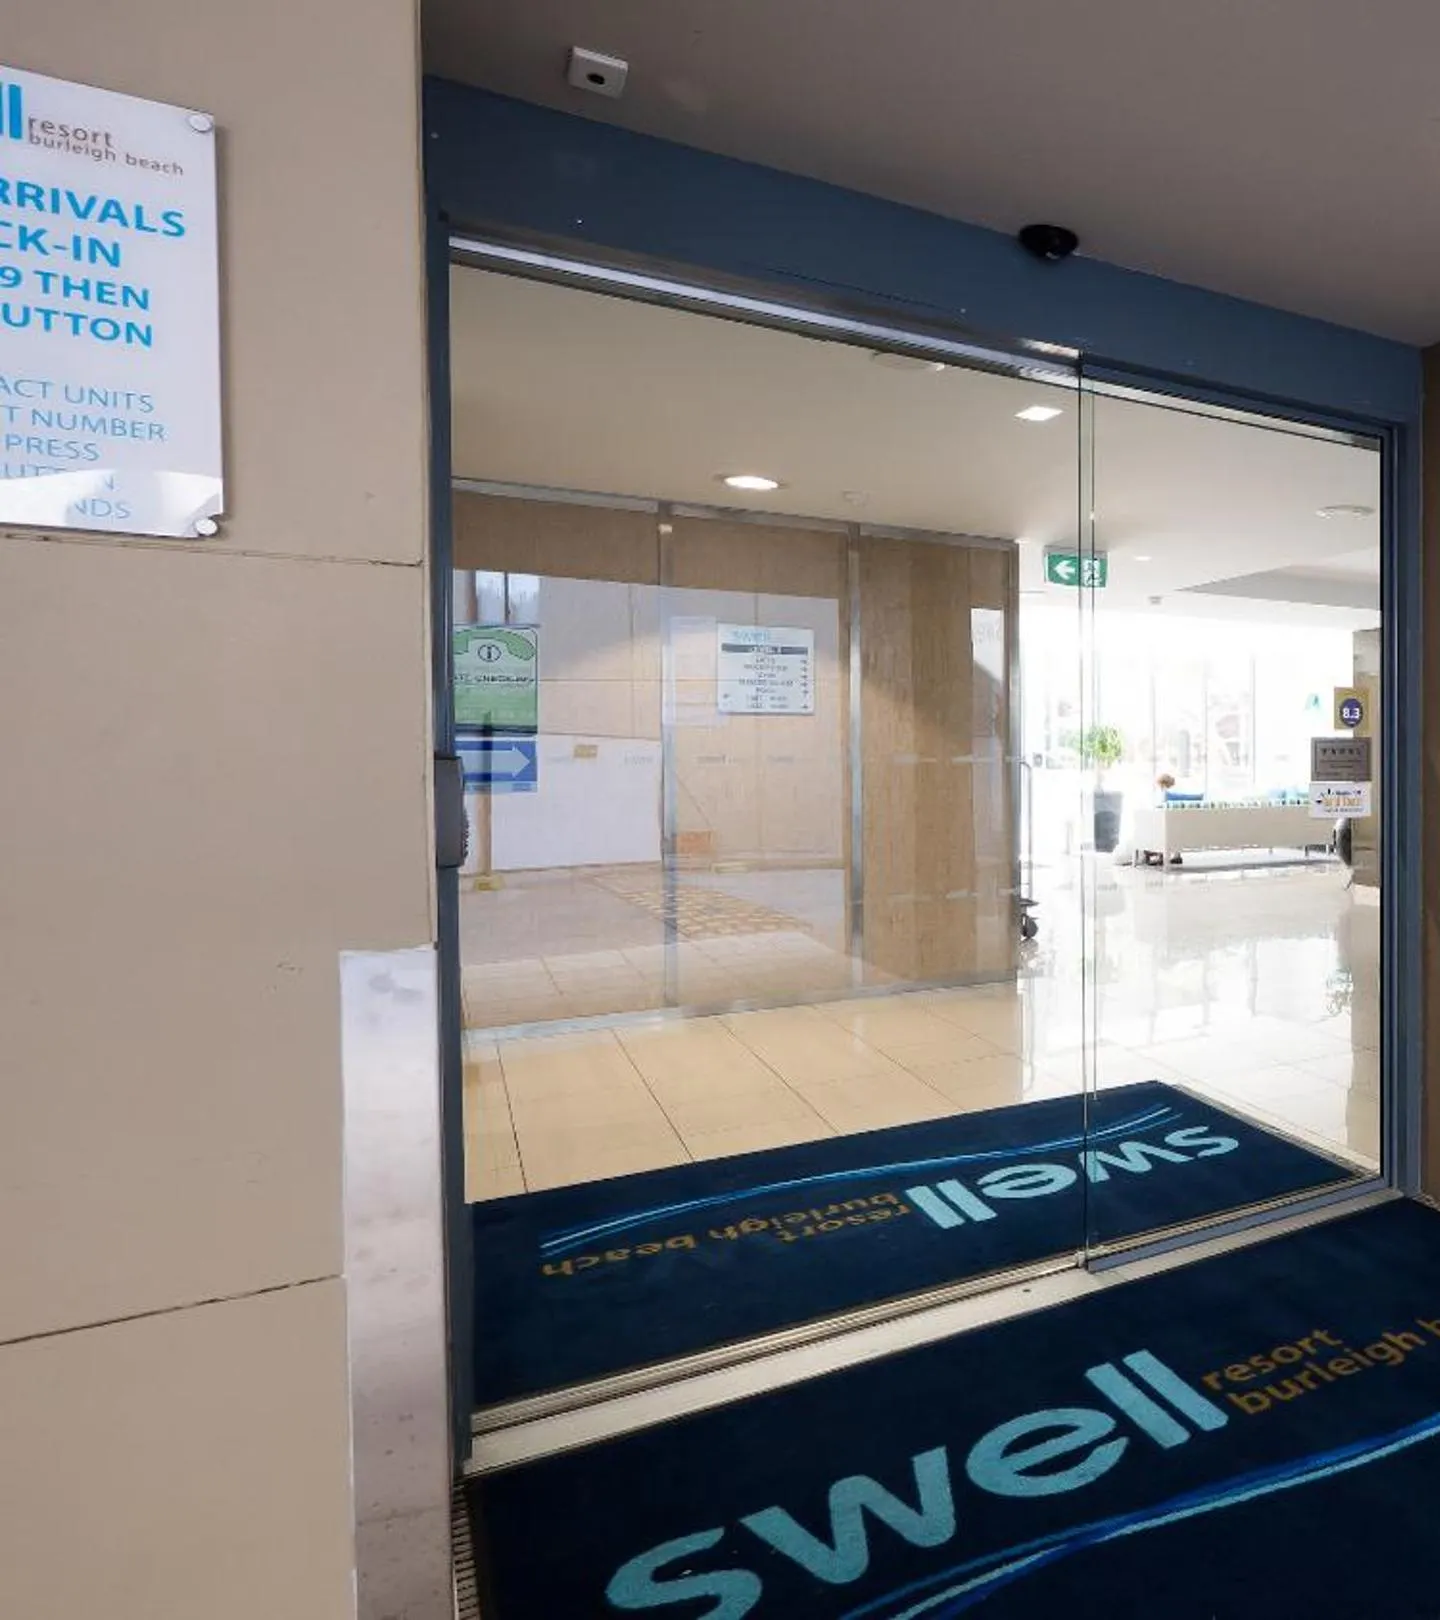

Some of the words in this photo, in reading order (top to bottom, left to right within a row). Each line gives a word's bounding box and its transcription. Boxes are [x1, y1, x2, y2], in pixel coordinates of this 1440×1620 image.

[28, 116, 114, 148] resort
[29, 133, 116, 162] burleigh
[125, 153, 184, 176] beach
[33, 270, 149, 310] THEN
[2, 303, 152, 347] UTTON
[64, 384, 155, 413] UNITS
[31, 408, 167, 442] NUMBER
[5, 433, 100, 461] PRESS
[905, 1125, 1239, 1229] swell
[708, 1192, 900, 1241] burleigh
[776, 1203, 911, 1243] resort
[540, 1234, 697, 1276] beach
[1201, 1329, 1344, 1391] resort
[1227, 1326, 1427, 1415] burleigh
[605, 1348, 1229, 1620] swell
